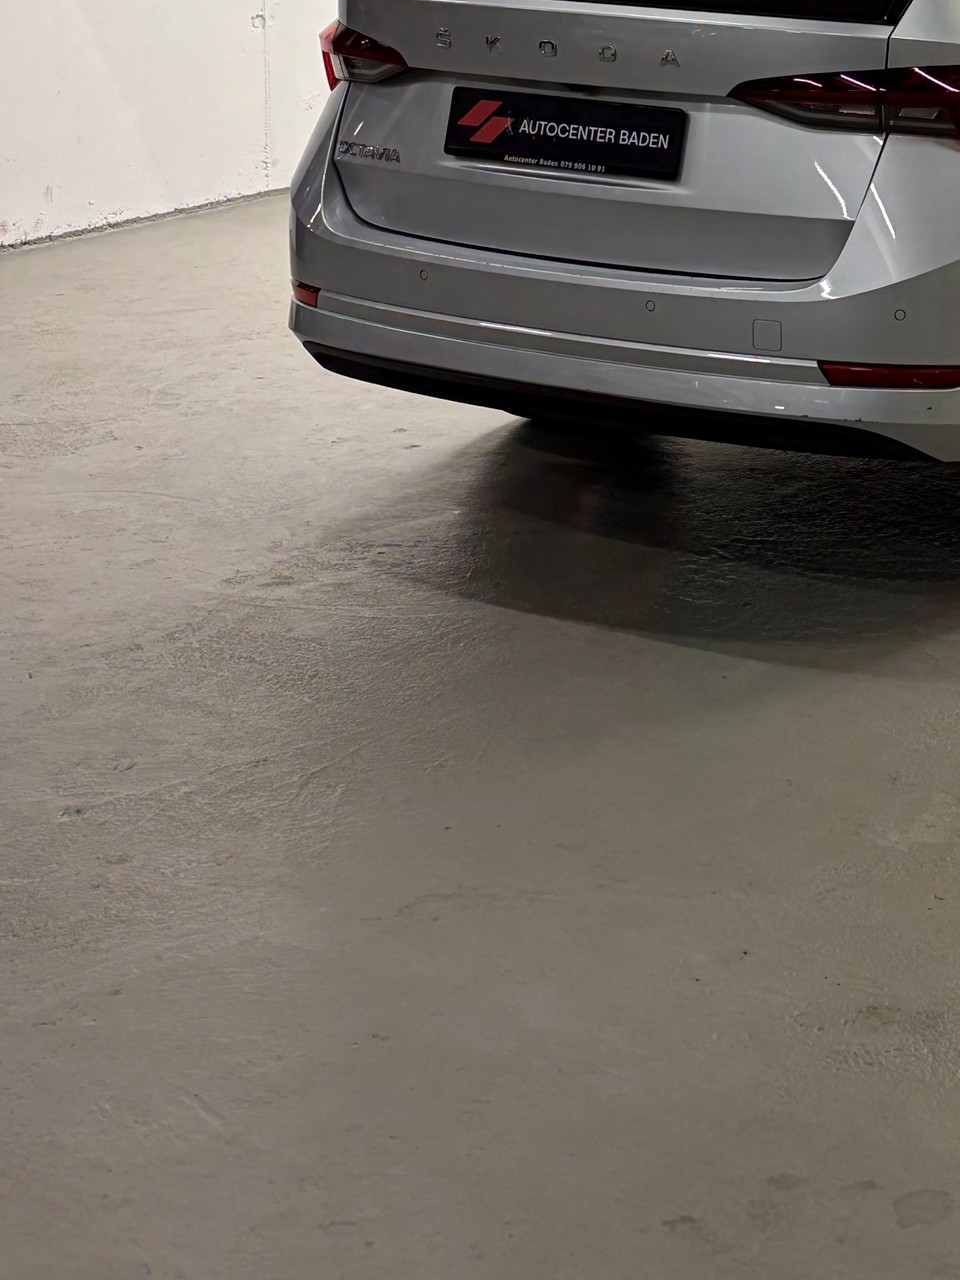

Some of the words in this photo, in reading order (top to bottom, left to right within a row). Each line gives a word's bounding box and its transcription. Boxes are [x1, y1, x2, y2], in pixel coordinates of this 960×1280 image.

[518, 119, 616, 144] AUTOCENTER
[619, 130, 669, 150] BADEN
[338, 140, 401, 164] OCTAVIA
[503, 154, 538, 165] Autocenter
[539, 158, 559, 167] Baden
[560, 160, 573, 169] 079
